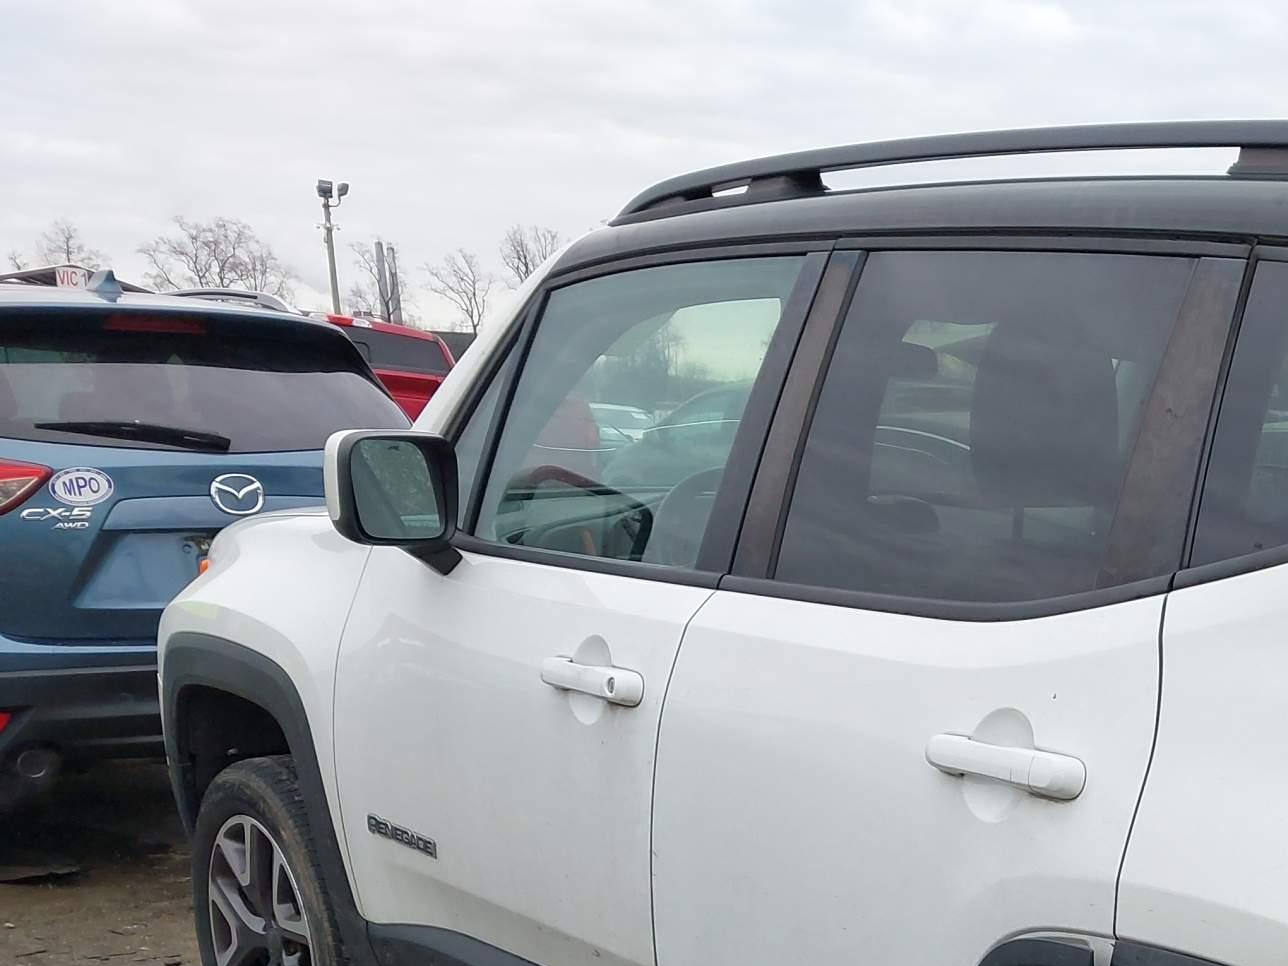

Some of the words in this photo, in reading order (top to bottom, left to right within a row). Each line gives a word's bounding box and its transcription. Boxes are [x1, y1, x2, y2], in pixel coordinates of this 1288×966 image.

[57, 270, 79, 287] VIC
[62, 476, 101, 497] MPO
[20, 506, 93, 521] CX-5
[52, 521, 90, 530] AWD
[366, 813, 438, 861] RENEGADE
